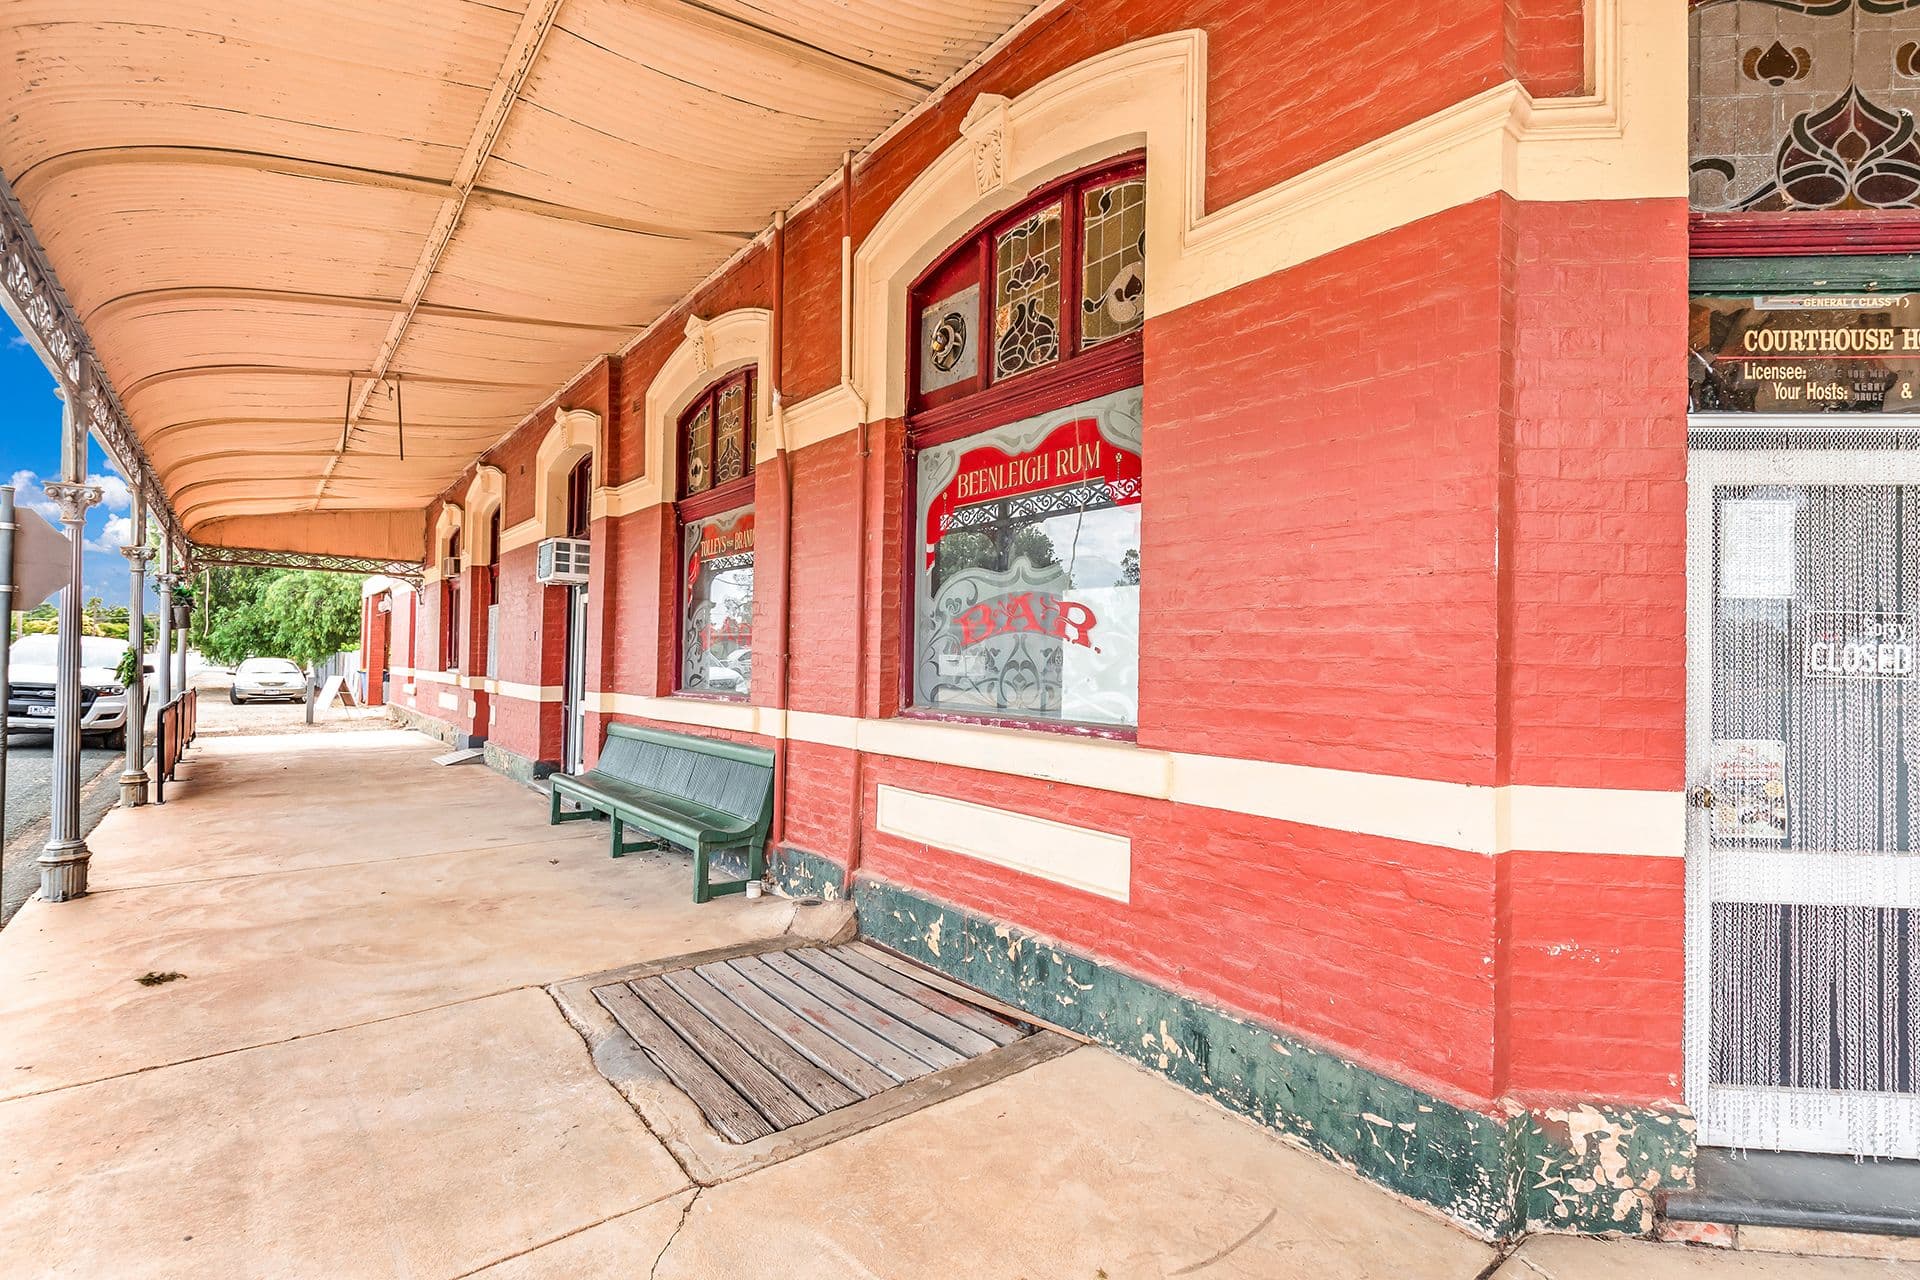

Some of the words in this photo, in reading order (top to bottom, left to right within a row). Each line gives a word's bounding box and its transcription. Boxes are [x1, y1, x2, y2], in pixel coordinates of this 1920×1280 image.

[1803, 298, 1847, 307] GENERAL
[1744, 328, 1894, 352] COURTHOUSE
[1902, 328, 1920, 350] H
[1744, 362, 1807, 380] Licensee:
[1773, 382, 1801, 400] Your
[1806, 382, 1848, 400] Hosts:
[1900, 382, 1913, 399] &
[957, 453, 1048, 499] BEENLEIGH
[1055, 440, 1101, 476] RUM
[1811, 642, 1912, 674] CLOSED
